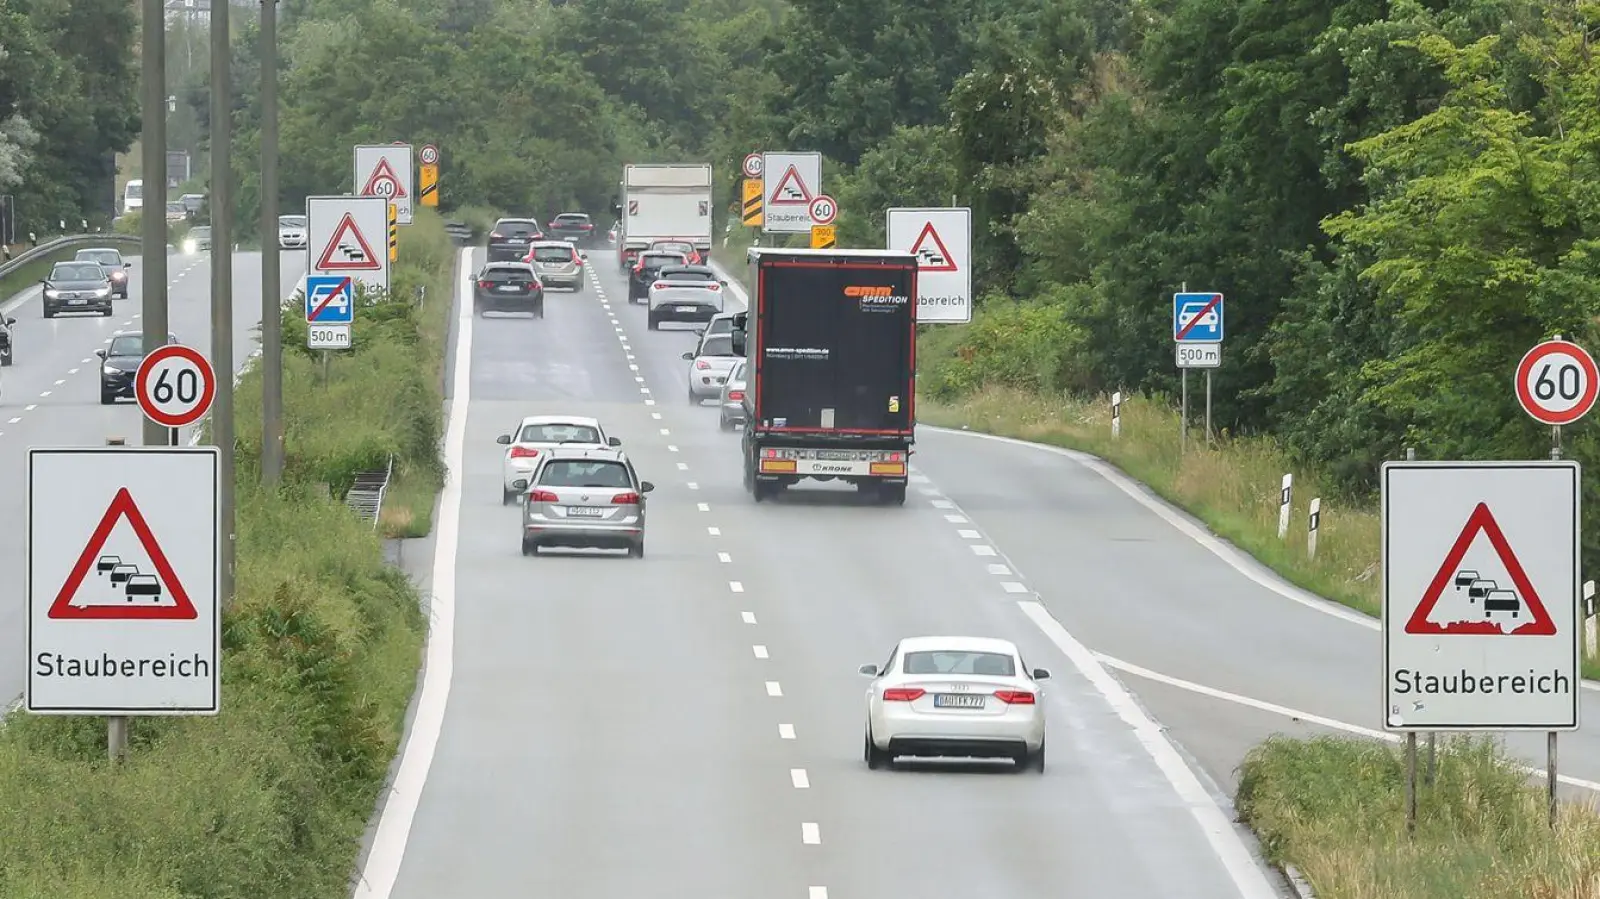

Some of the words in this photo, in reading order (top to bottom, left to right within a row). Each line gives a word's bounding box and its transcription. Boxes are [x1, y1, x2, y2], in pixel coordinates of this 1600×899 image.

[424, 151, 434, 160] 60
[748, 160, 761, 170] 60
[376, 182, 392, 194] 60
[815, 204, 830, 216] 60
[862, 296, 908, 304] SPEDITION
[312, 331, 333, 341] 500
[336, 333, 347, 341] m
[1181, 349, 1202, 360] 500
[1206, 351, 1217, 360] m
[154, 369, 197, 404] 60
[1535, 364, 1580, 400] 60
[36, 652, 209, 677] Staubereich
[1394, 669, 1569, 694] Staubereich
